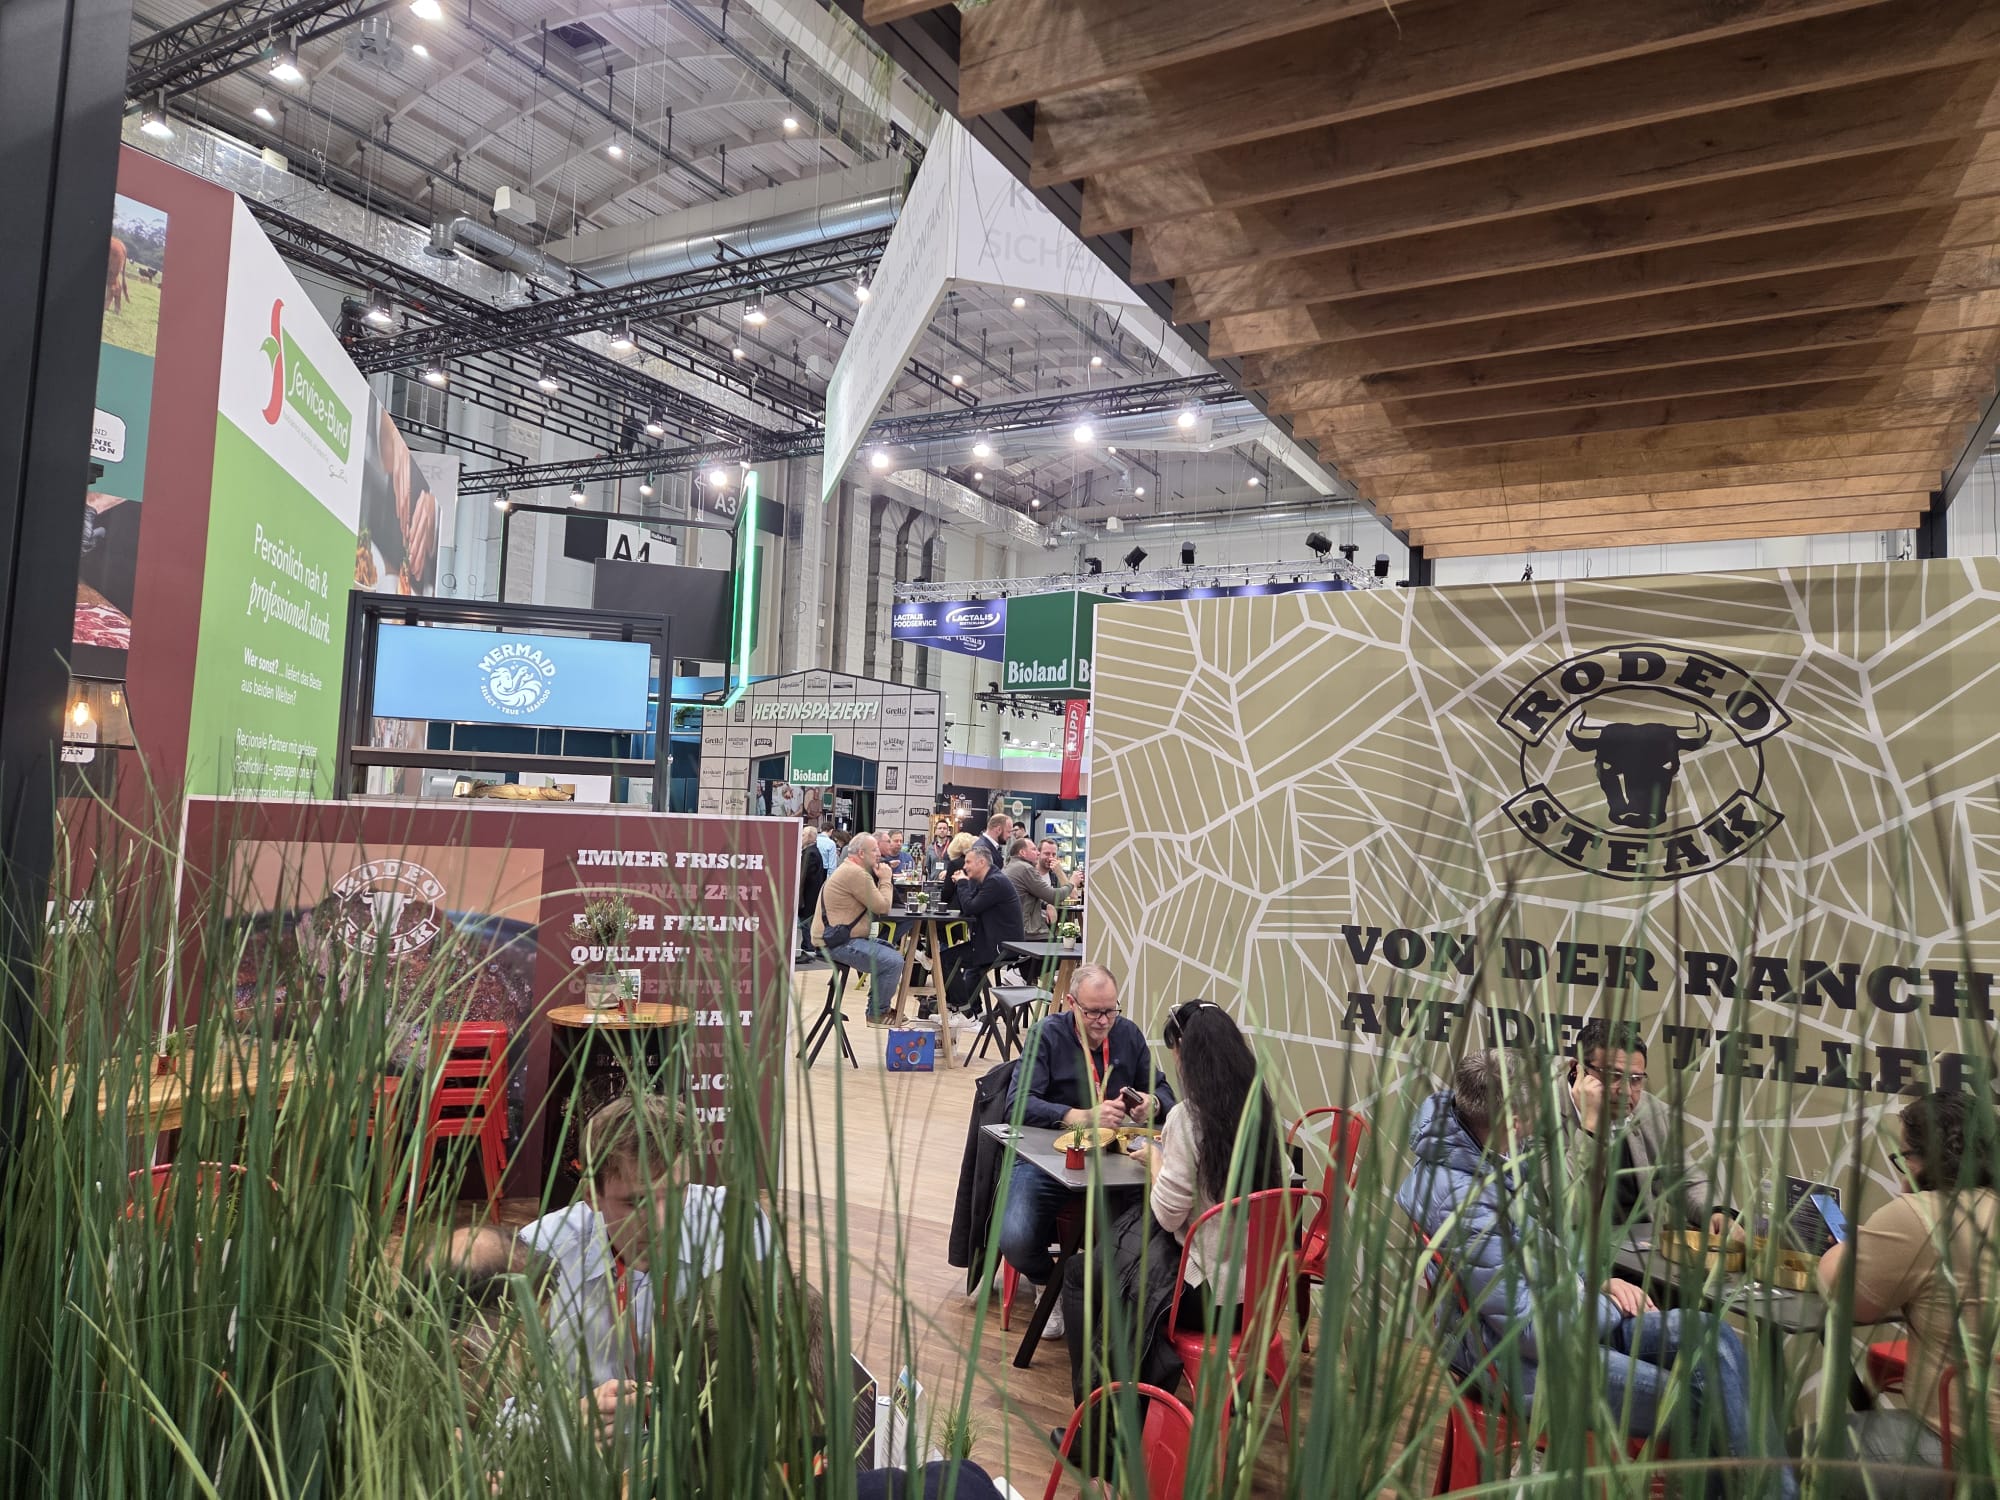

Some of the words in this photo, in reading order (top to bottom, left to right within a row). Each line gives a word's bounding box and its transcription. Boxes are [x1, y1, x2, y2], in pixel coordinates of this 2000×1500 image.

[288, 361, 349, 449] Service-Bund
[714, 492, 736, 515] A3
[254, 522, 304, 584] Persönlich
[304, 563, 320, 594] nah
[320, 570, 329, 600] &
[893, 613, 924, 621] LACTALIS
[951, 613, 994, 623] LACTALIS
[893, 619, 937, 628] FOODSERVICE
[244, 646, 259, 668] Wer
[258, 658, 280, 676] sonst?
[309, 672, 323, 691] Beste
[478, 643, 556, 677] MERMAID
[1007, 658, 1068, 684] Bioland
[240, 679, 253, 693] aus
[253, 676, 275, 700] beiden
[275, 684, 298, 706] Welten?
[1511, 651, 1770, 735] RODEO
[751, 701, 880, 721] HEREINSPAZIERT!
[236, 727, 267, 751] Regionale
[267, 733, 289, 753] Partner
[1065, 709, 1080, 752] RUPP
[792, 769, 829, 782] Bioland
[1518, 800, 1766, 874] STEAK
[576, 850, 669, 867] IMMER
[675, 852, 764, 870] FRISCH
[704, 884, 762, 900] ZART
[570, 941, 691, 965] QUALITÄT
[1341, 925, 1478, 975] VON
[1501, 938, 1659, 991] DER
[1684, 950, 1994, 1021] RANCH
[1340, 992, 1464, 1042] AUF
[1487, 1006, 1642, 1057] DE
[1662, 1025, 1990, 1099] TELLER
